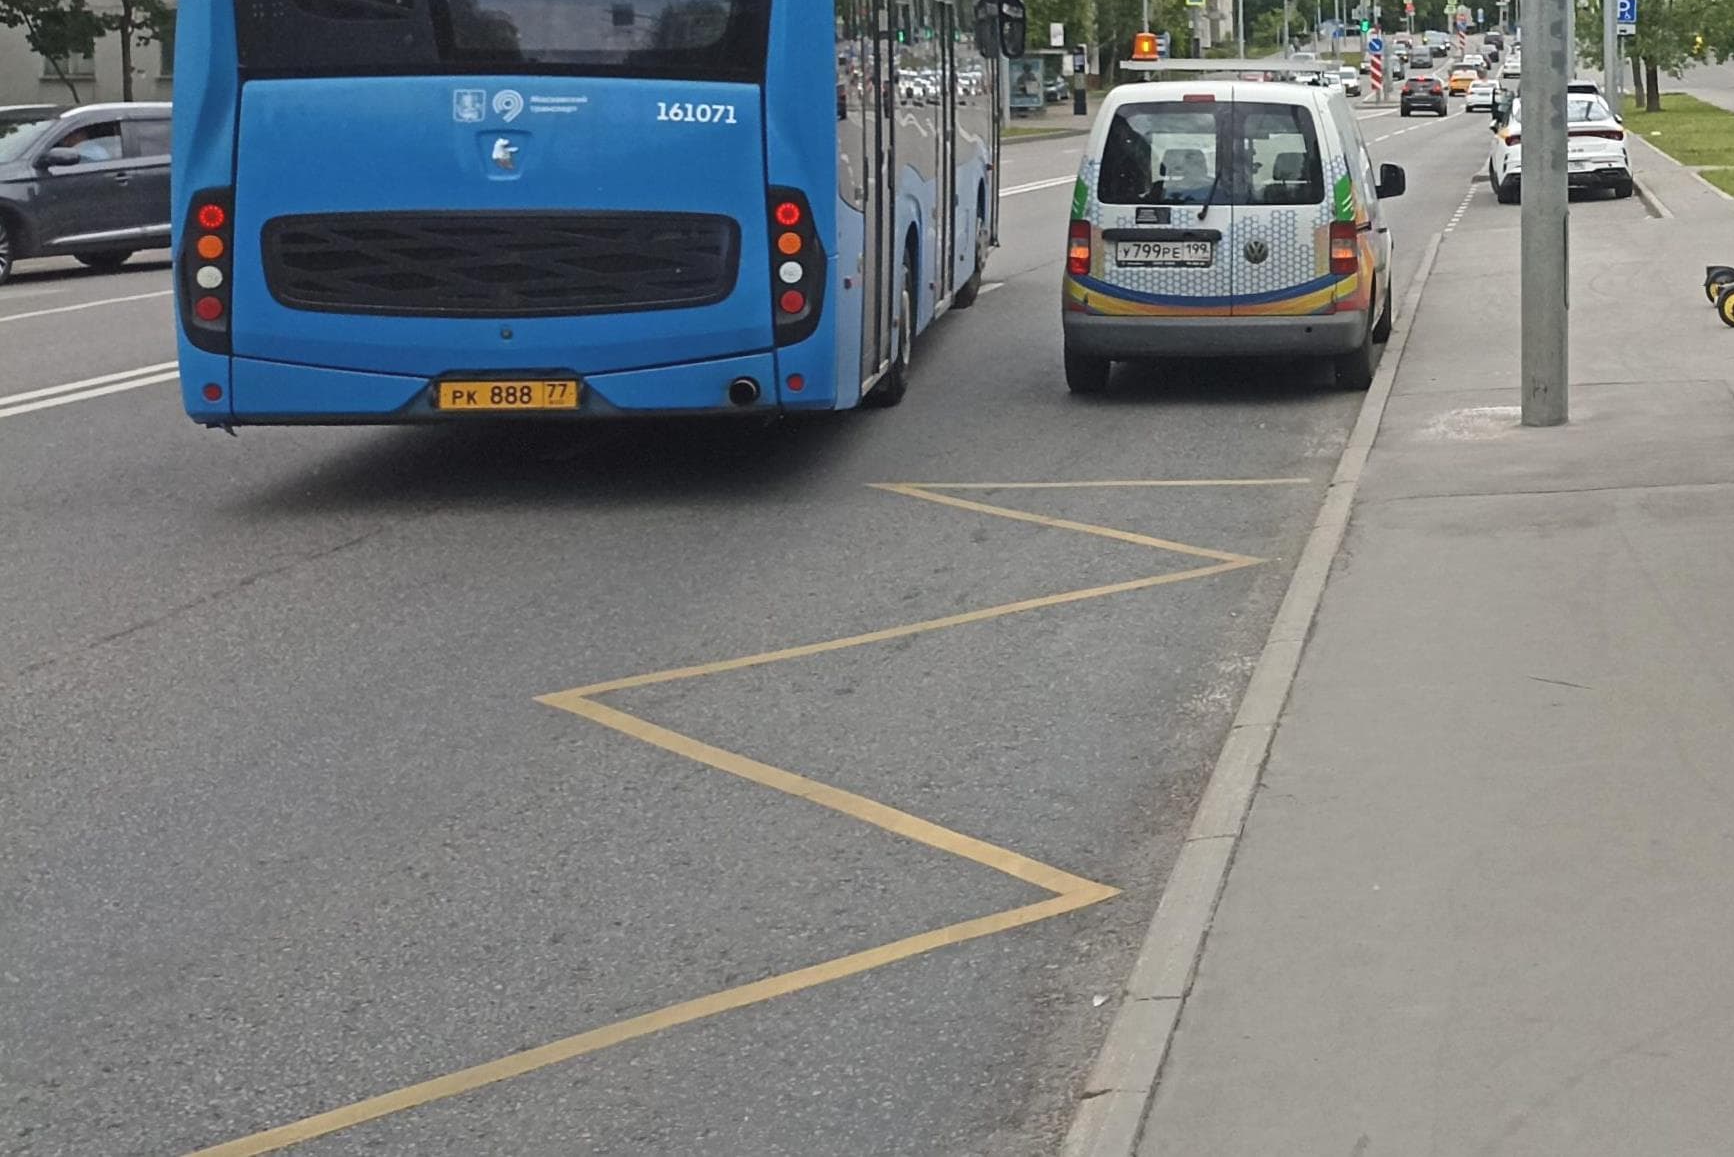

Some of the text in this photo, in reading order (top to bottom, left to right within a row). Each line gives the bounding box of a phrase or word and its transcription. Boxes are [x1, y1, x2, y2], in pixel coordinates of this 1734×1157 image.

[656, 101, 738, 125] 161071
[1186, 244, 1207, 254] 199
[490, 384, 533, 405] 888
[547, 383, 568, 398] 77
